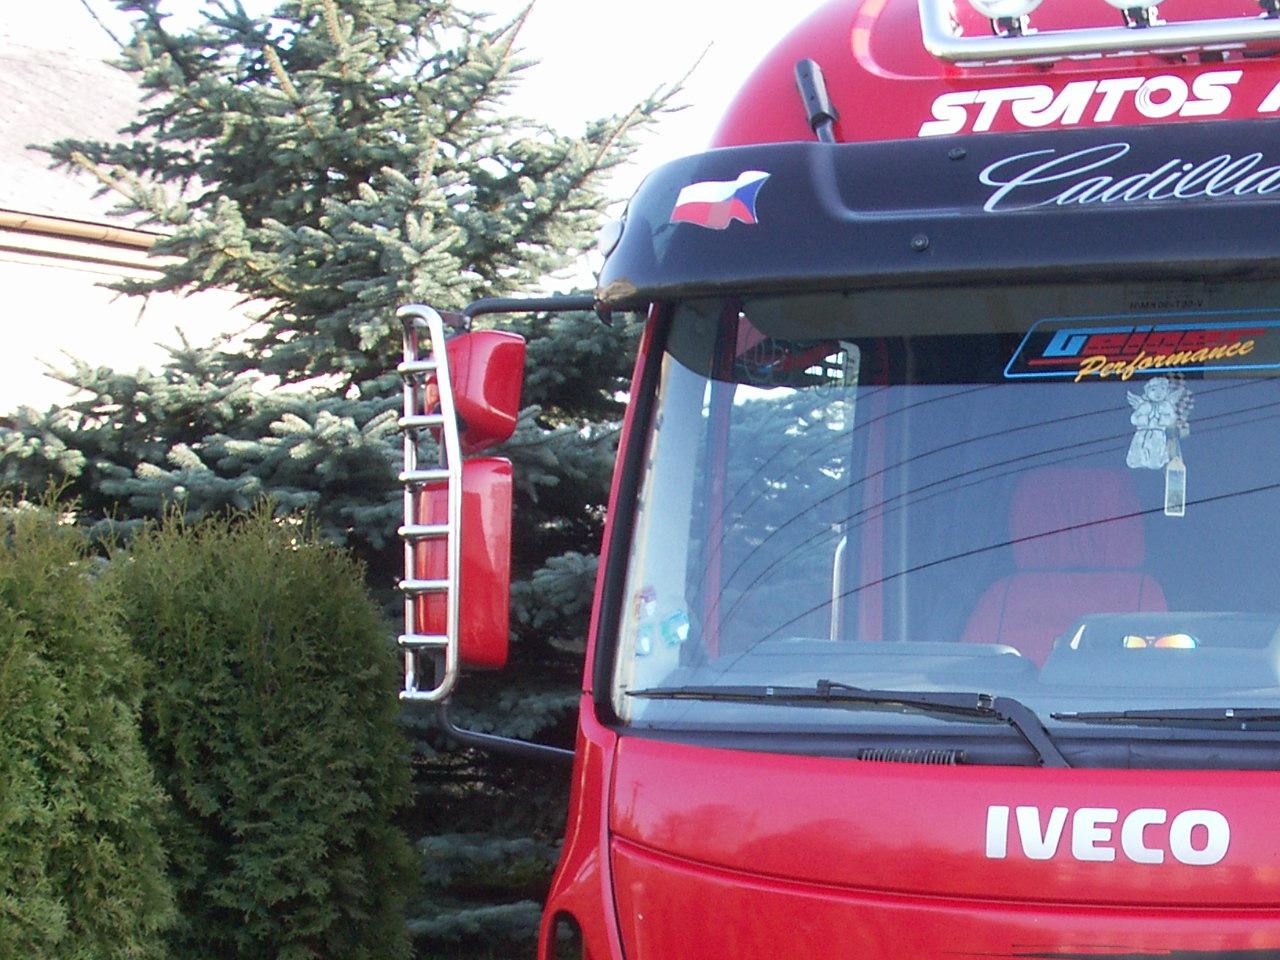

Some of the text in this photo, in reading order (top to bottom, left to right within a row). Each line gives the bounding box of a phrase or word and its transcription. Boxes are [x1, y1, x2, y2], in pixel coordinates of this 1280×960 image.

[918, 70, 1242, 138] STRATOS
[1074, 338, 1256, 384] Performance
[985, 805, 1231, 866] IVECO
